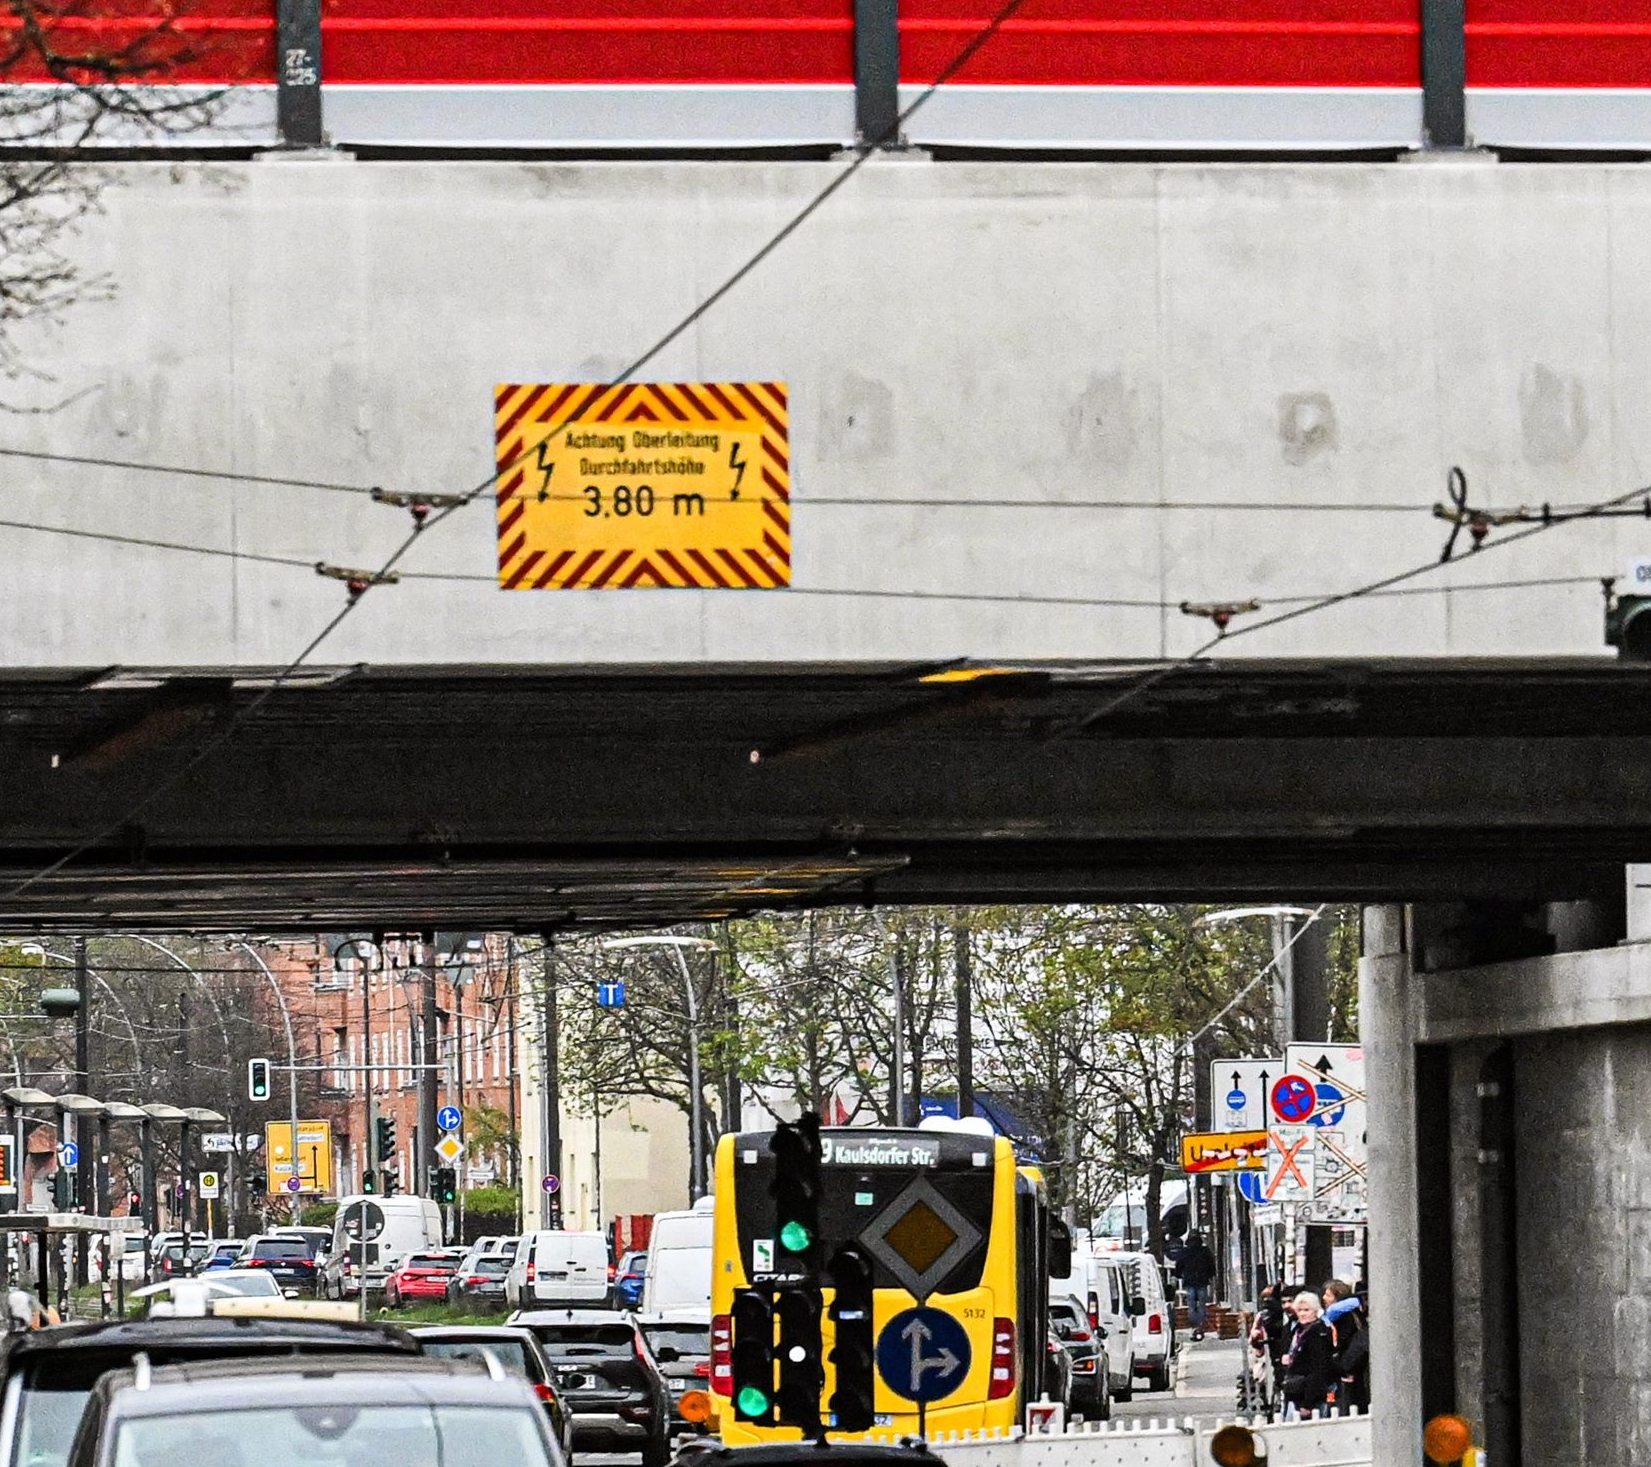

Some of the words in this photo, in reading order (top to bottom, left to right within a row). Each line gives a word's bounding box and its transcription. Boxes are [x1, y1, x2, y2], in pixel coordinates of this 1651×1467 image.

[565, 432, 626, 452] Achtung
[584, 485, 654, 518] 3.80
[673, 493, 705, 516] m
[603, 984, 619, 1005] T
[835, 1146, 908, 1165] Kaulsdorfer
[911, 1146, 935, 1165] Str.
